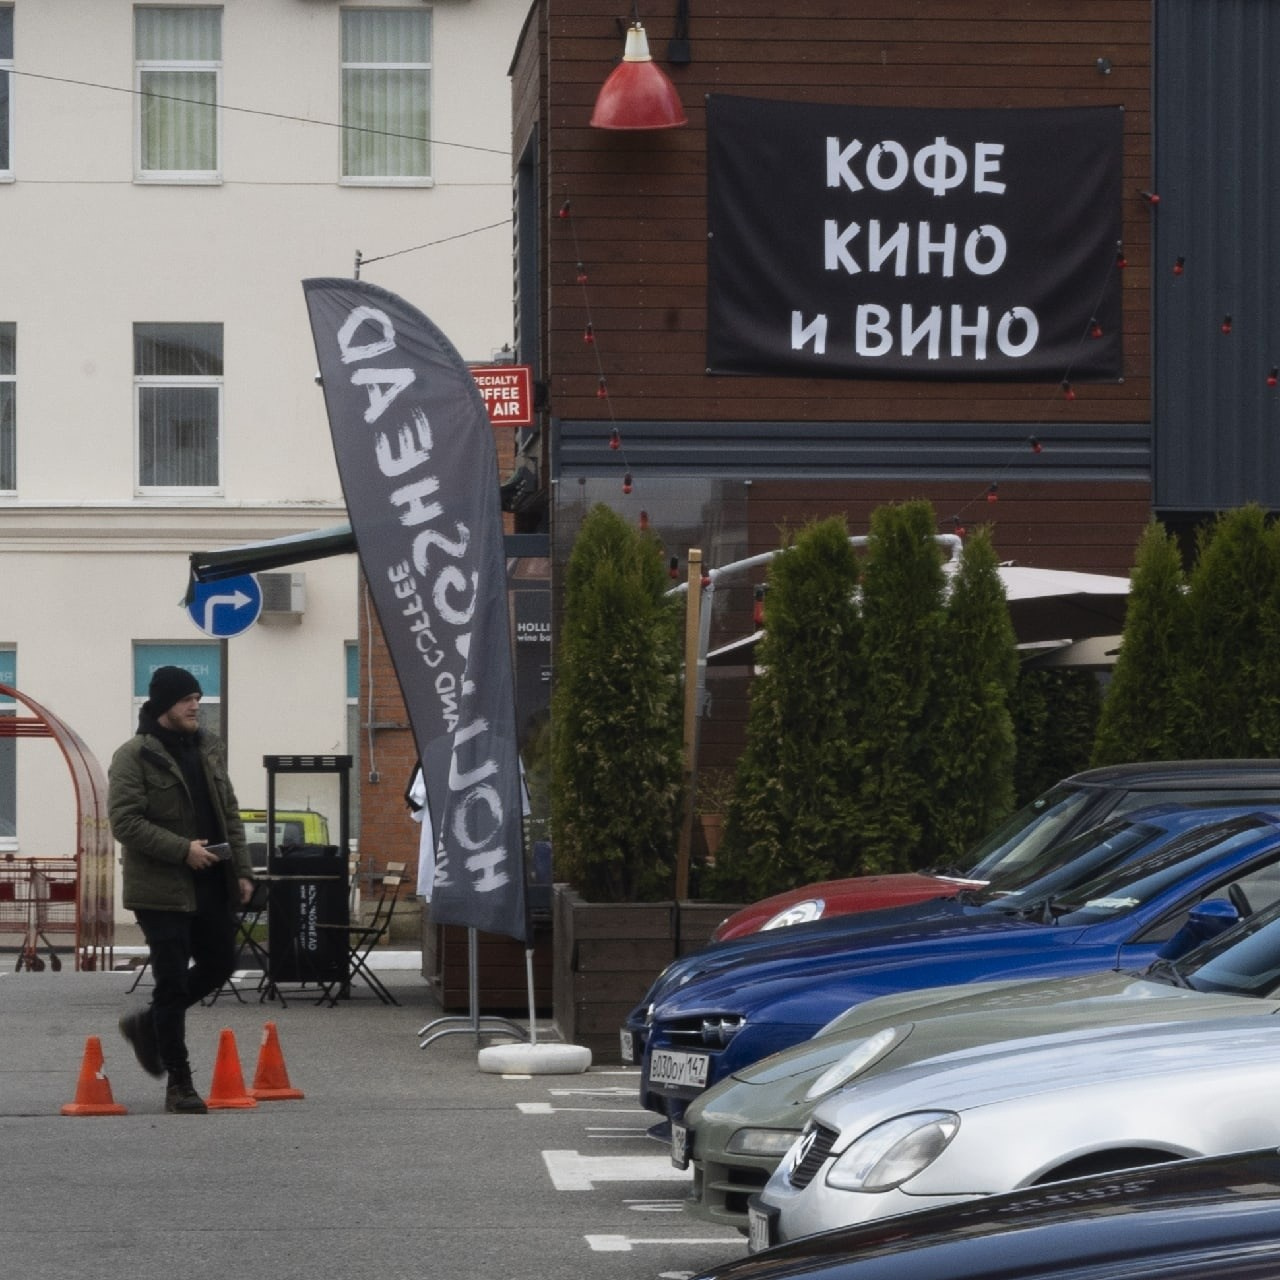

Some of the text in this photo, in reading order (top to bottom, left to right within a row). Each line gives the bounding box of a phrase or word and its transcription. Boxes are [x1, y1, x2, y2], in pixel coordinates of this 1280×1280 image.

[826, 136, 1007, 197] КОФЕ
[824, 219, 1008, 278] КИНО
[791, 303, 1041, 361] и ВИНО
[493, 401, 520, 416] AIR
[687, 1056, 705, 1077] 147
